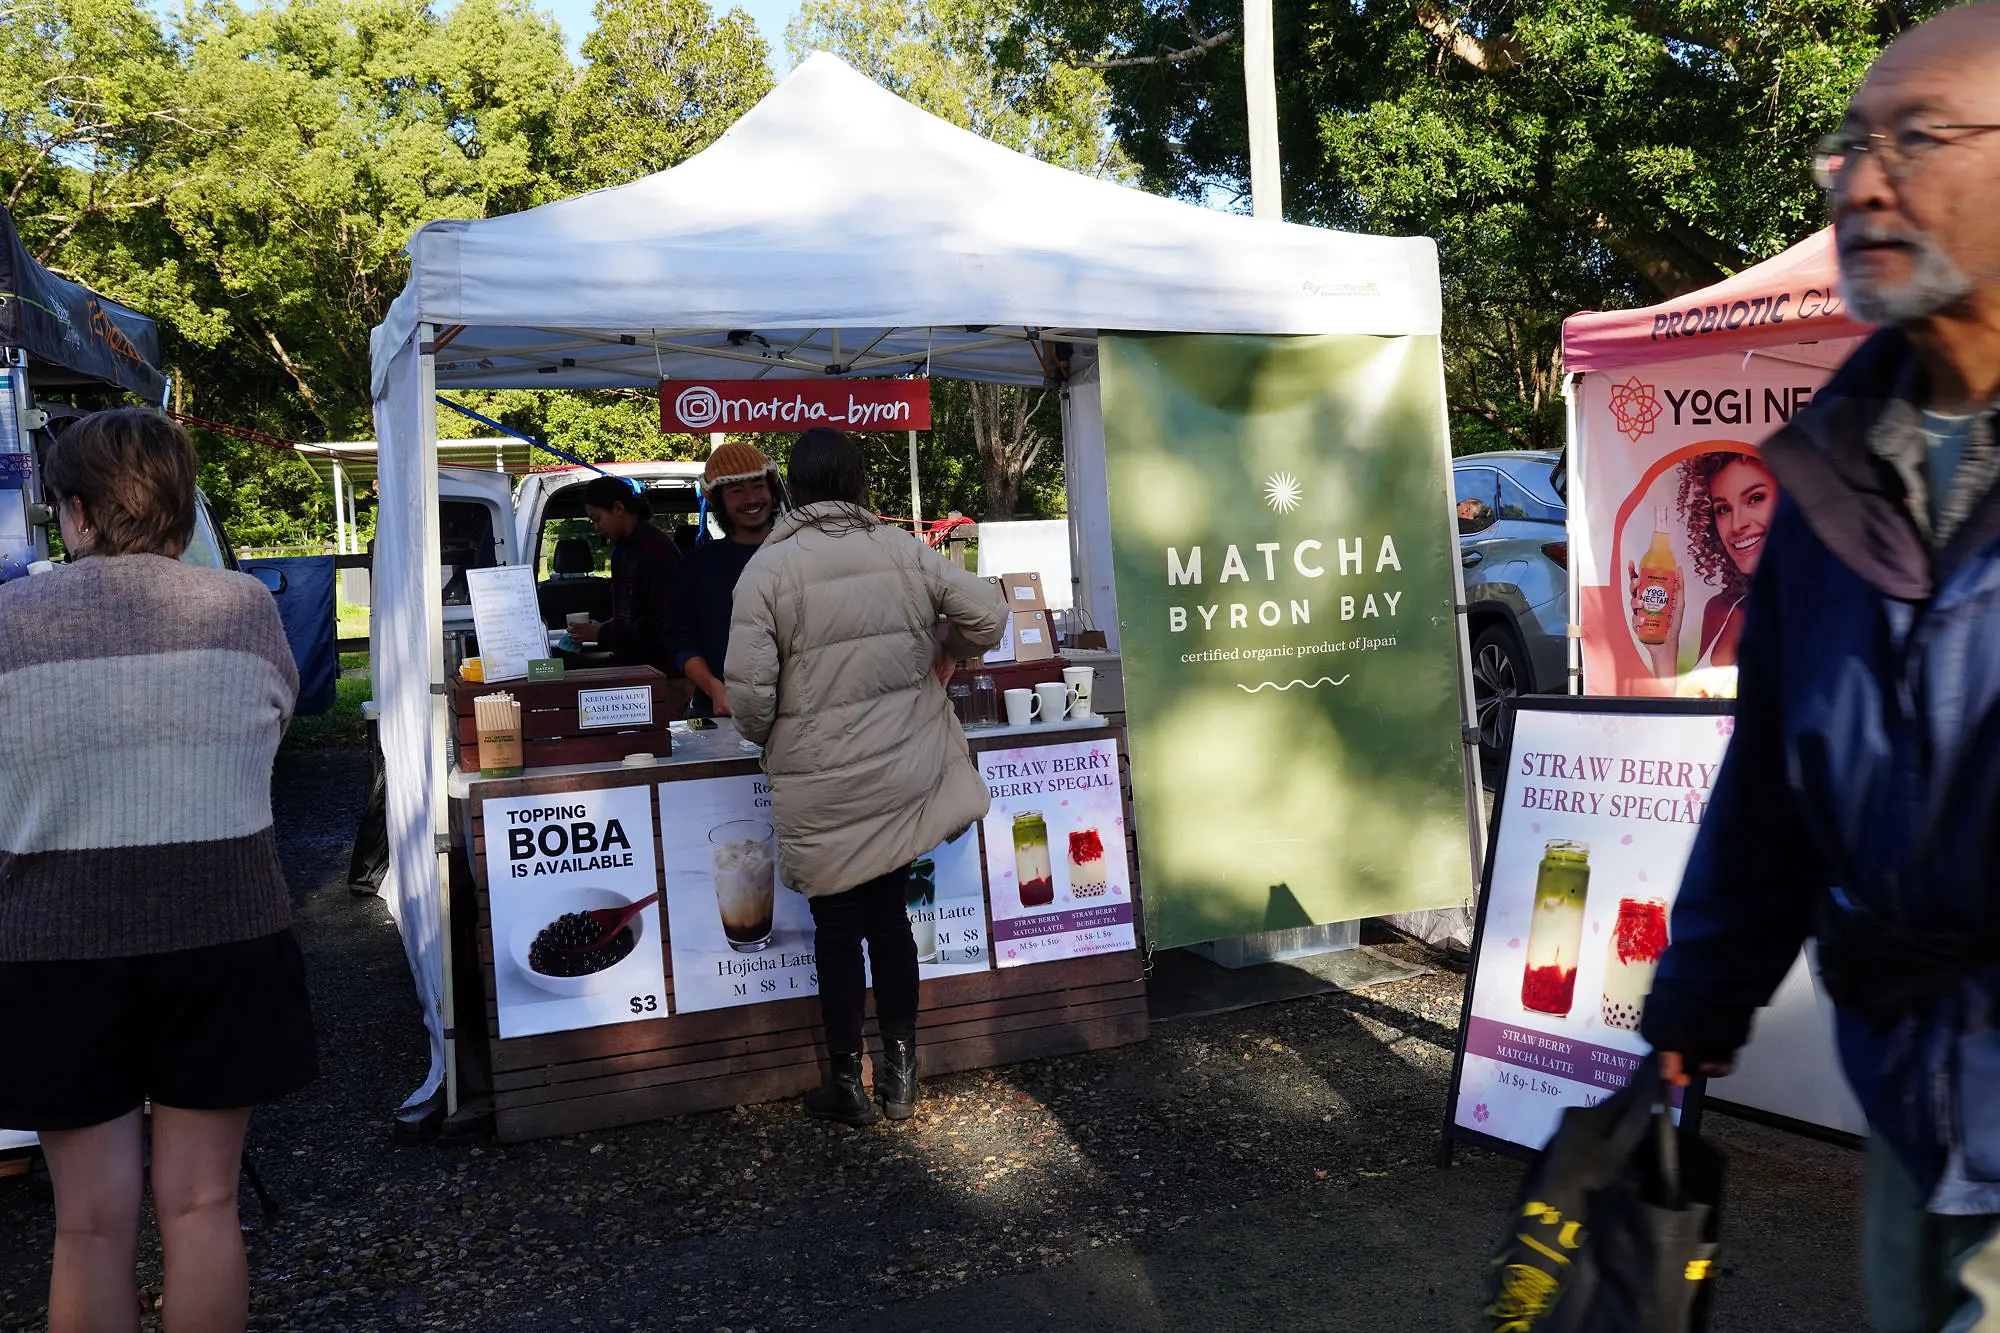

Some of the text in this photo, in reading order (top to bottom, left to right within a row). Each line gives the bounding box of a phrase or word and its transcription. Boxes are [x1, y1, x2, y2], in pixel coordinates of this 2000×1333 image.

[1651, 293, 1790, 340] PROBIOTIC
[1167, 535, 1401, 586] MATCHA
[1169, 591, 1401, 632] BYRON BAY
[1181, 634, 1397, 663] certified organic product of Japan
[584, 702, 646, 714] CASH IS KING
[986, 754, 1112, 781] STRAW BERRY
[1521, 752, 1718, 790] STRAW BERRY
[990, 773, 1113, 798] BERRY SPECIAL
[1521, 786, 1605, 815] BERRY
[506, 804, 586, 825] TOPPING
[508, 818, 632, 861] BOBA
[511, 852, 634, 878] IS AVAILABLE
[939, 906, 975, 920] Latte
[1014, 915, 1061, 927] STRAW BERRY
[1071, 907, 1118, 919] STRAW BERRY
[1076, 919, 1101, 928] BUBBLE
[938, 928, 979, 945] M $8
[1013, 924, 1065, 937] MATCHA LATTE
[1076, 934, 1083, 942] M
[1096, 931, 1101, 939] L
[941, 945, 980, 961] L $9
[1019, 943, 1028, 951] M
[717, 956, 776, 978] Hojicha
[734, 983, 747, 997] M
[760, 979, 776, 994] $8
[789, 976, 798, 989] L
[629, 994, 658, 1014] $3
[1502, 1029, 1573, 1055] STRAW BERRY
[1496, 1045, 1575, 1074] MATCHA LATTE
[1590, 1050, 1628, 1069] STRAW
[1498, 1071, 1510, 1084] M
[1531, 1078, 1538, 1091] L
[1594, 1069, 1632, 1088] BUBBL
